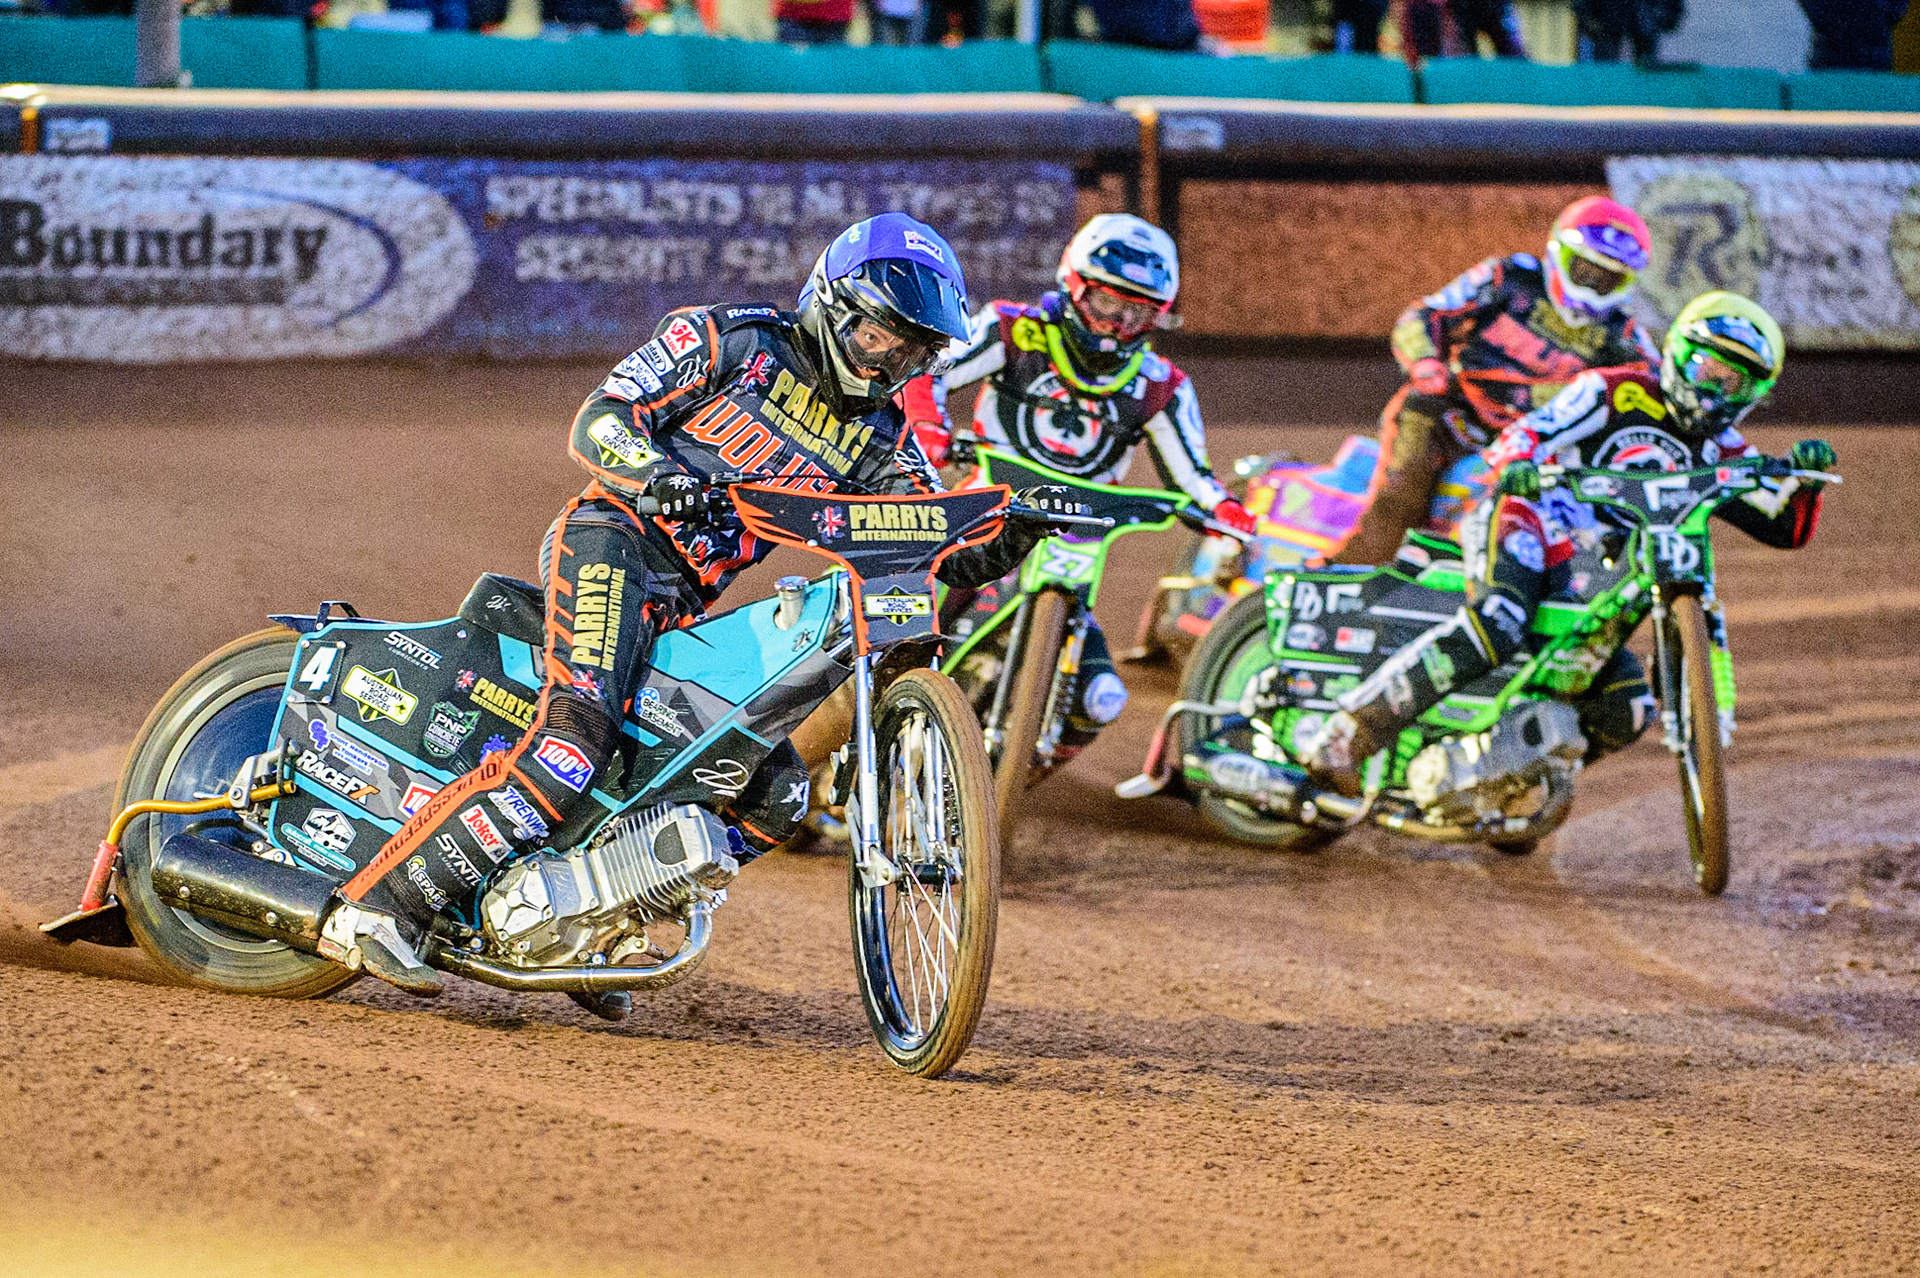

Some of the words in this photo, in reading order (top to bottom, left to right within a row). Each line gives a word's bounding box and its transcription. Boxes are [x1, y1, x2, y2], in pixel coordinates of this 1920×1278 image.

[0, 200, 328, 283] Boundary
[848, 504, 949, 532] PARRYS
[851, 530, 948, 542] INTERNATIONAL
[570, 563, 612, 667] PARRYS
[601, 568, 626, 671] INTERNATIONAL
[383, 631, 441, 670] SYNTOL
[300, 646, 339, 691] 4
[359, 690, 391, 712] SERVICES
[361, 675, 404, 702] AUSTRALIAN
[369, 687, 390, 702] ROAD
[472, 677, 537, 722] PARRYS
[435, 713, 468, 735] PNP
[643, 698, 676, 720] BEARING
[427, 723, 461, 747] CONCRETE
[350, 745, 387, 768] Henderson
[540, 744, 590, 786] 100%
[297, 750, 381, 805] RACEFX
[464, 808, 500, 846] Joker
